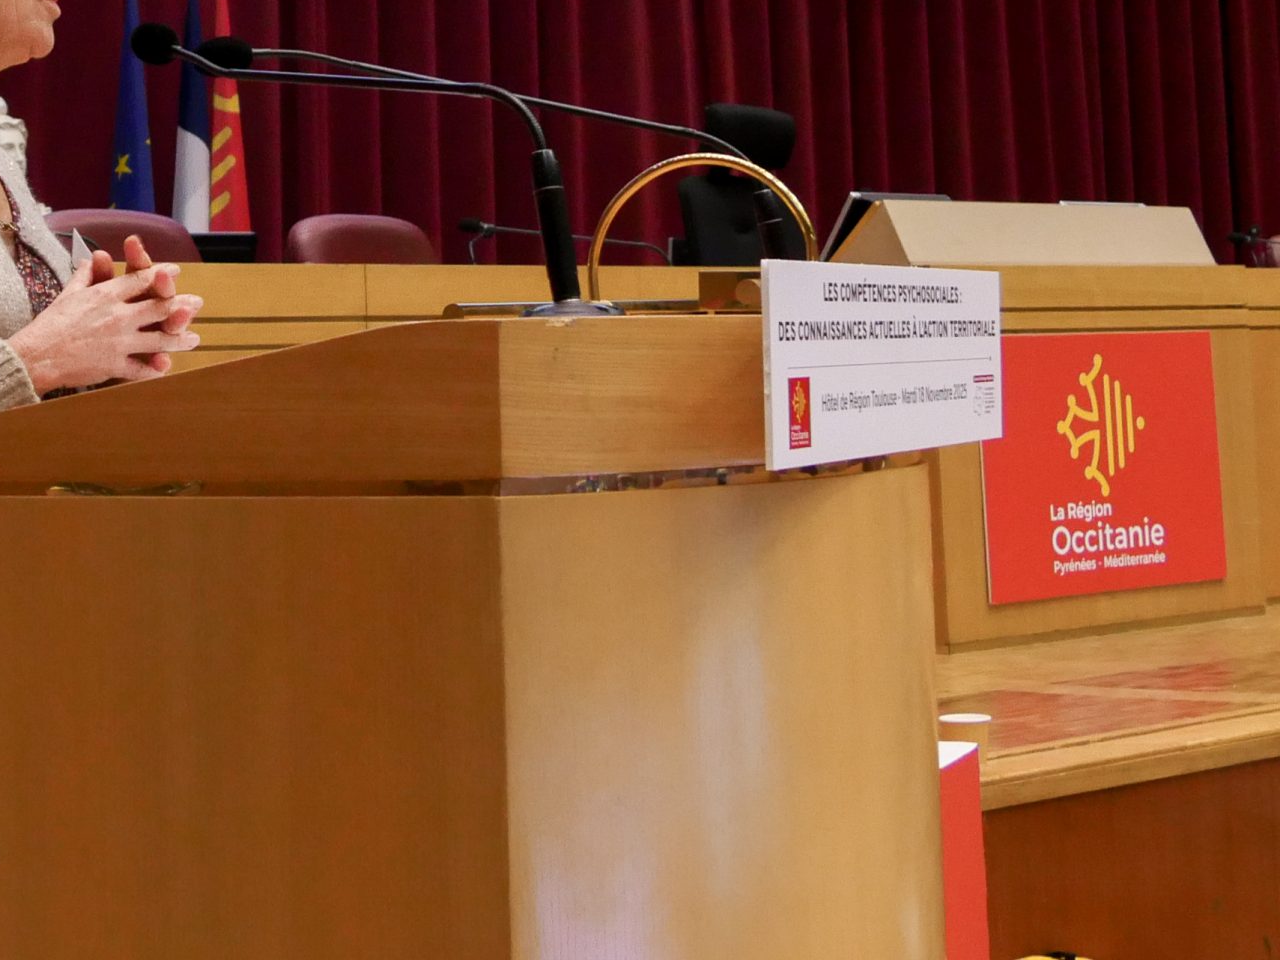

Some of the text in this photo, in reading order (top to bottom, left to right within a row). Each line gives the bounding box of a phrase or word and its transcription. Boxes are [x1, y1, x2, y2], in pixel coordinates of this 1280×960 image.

[823, 282, 838, 302] LES
[840, 278, 896, 302] COMPÉTENCES
[898, 284, 958, 303] PSYCHOSOCIALES
[778, 315, 995, 341] DES CONNAISSANCES ACTUELLES À L'ACTION TERRITORIALE
[822, 393, 839, 412] Hôtel
[840, 393, 848, 410] de
[849, 390, 870, 412] Région
[871, 390, 897, 407] Toulouse
[926, 386, 952, 402] Novembre
[954, 383, 967, 399] 2025
[1050, 500, 1112, 522] La Région
[1052, 516, 1165, 555] Occitanie
[1054, 558, 1096, 576] Pyrénées
[1104, 550, 1166, 568] Méditerranée
